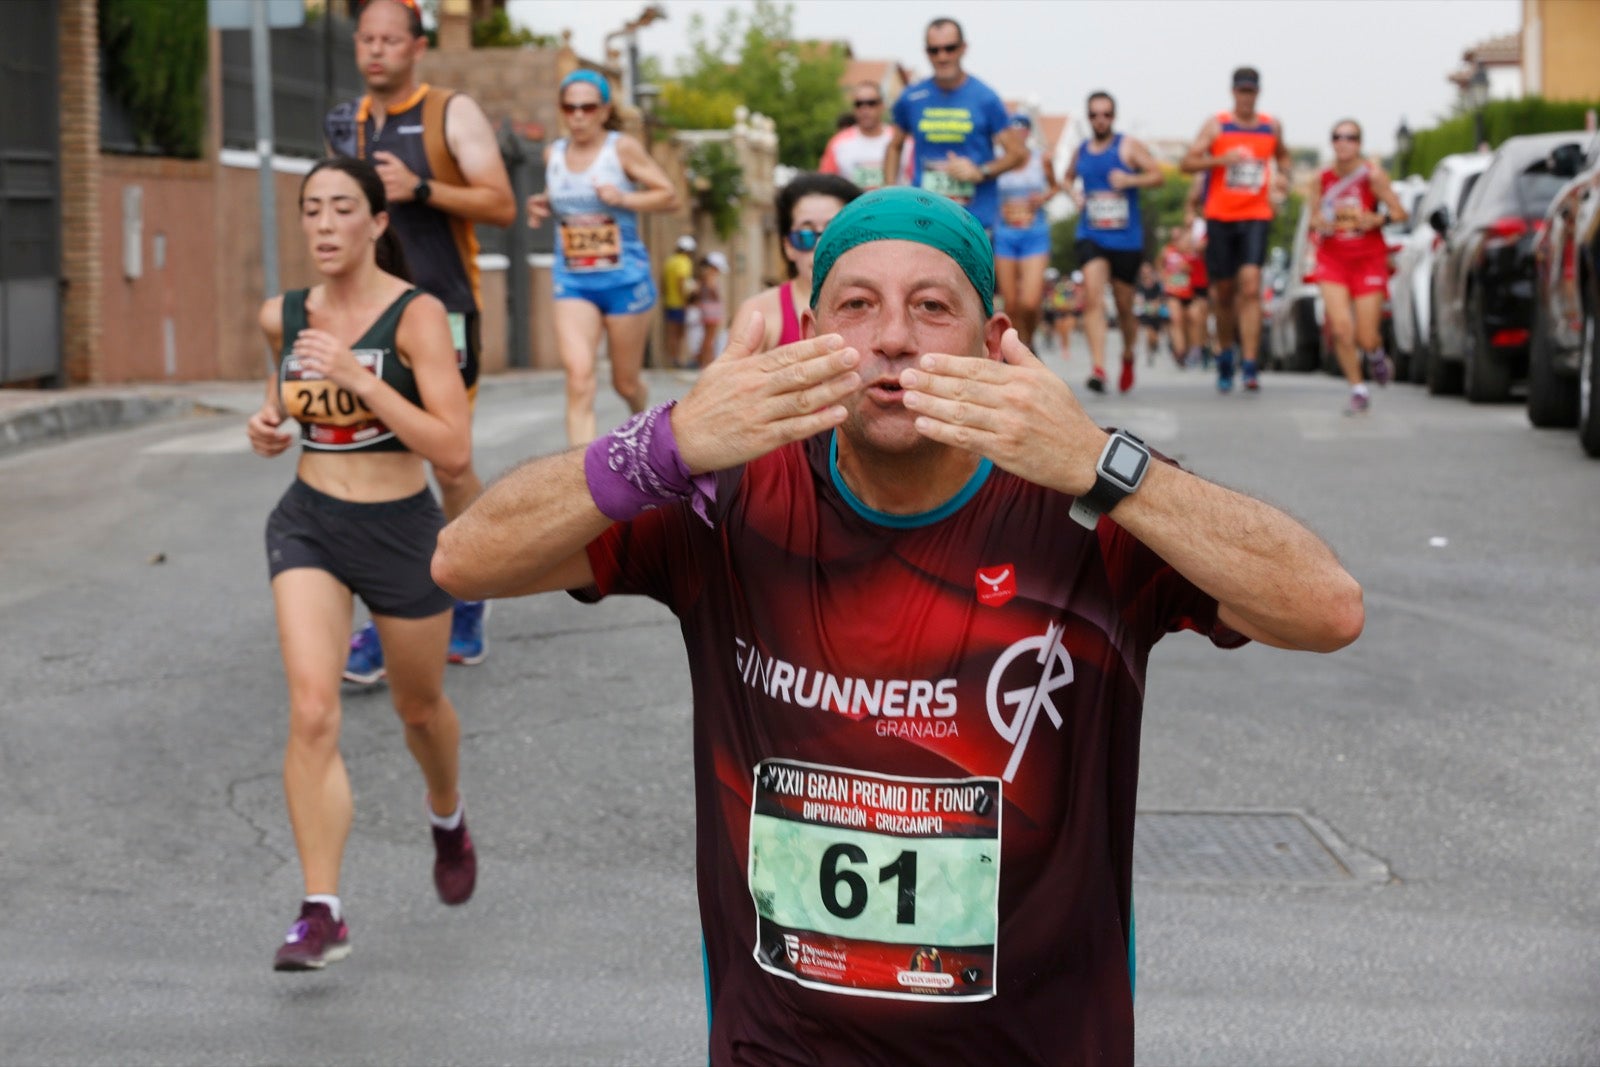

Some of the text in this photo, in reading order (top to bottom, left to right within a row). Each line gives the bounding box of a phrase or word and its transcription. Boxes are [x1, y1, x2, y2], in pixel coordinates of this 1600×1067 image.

[875, 718, 959, 739] GRANADA
[807, 772, 849, 801] GRAN
[852, 782, 908, 812] PREMIO
[911, 786, 932, 813] DE
[803, 800, 867, 827] DIPUTACIÓN
[875, 811, 943, 834] CRUZCAMPO
[818, 843, 918, 926] 61
